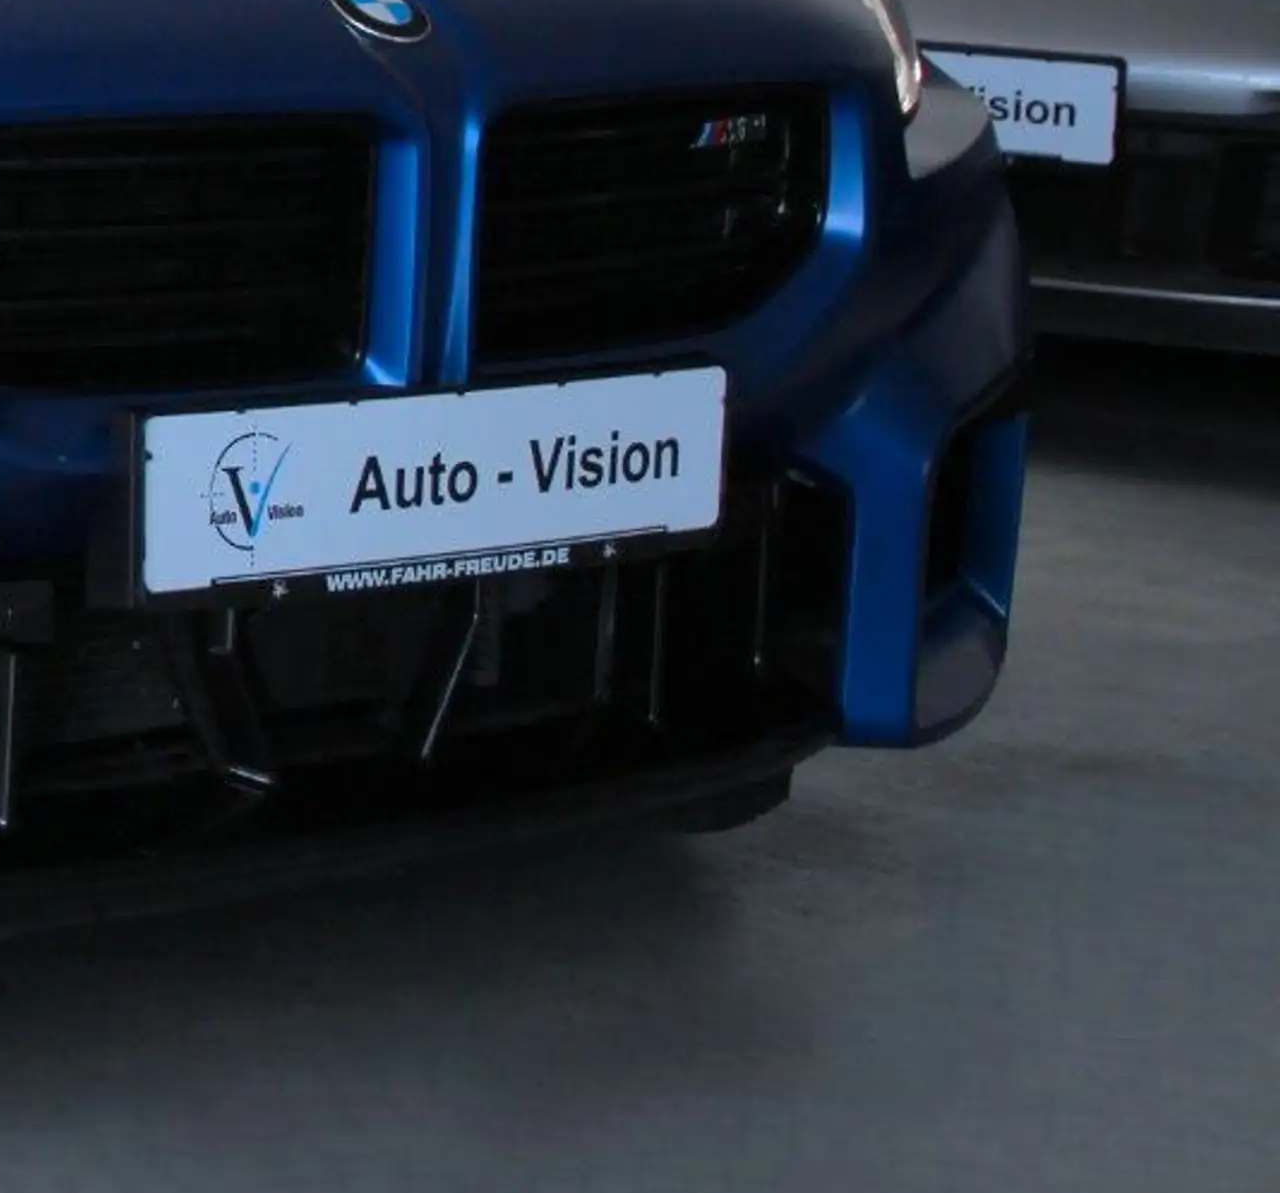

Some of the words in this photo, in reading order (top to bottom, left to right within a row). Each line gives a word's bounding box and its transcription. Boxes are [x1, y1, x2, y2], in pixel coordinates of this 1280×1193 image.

[969, 85, 1077, 127] sion
[350, 451, 479, 514] Auto
[529, 430, 680, 494] Vision
[326, 546, 571, 593] WWW.FAHR-FREUDE.DE
